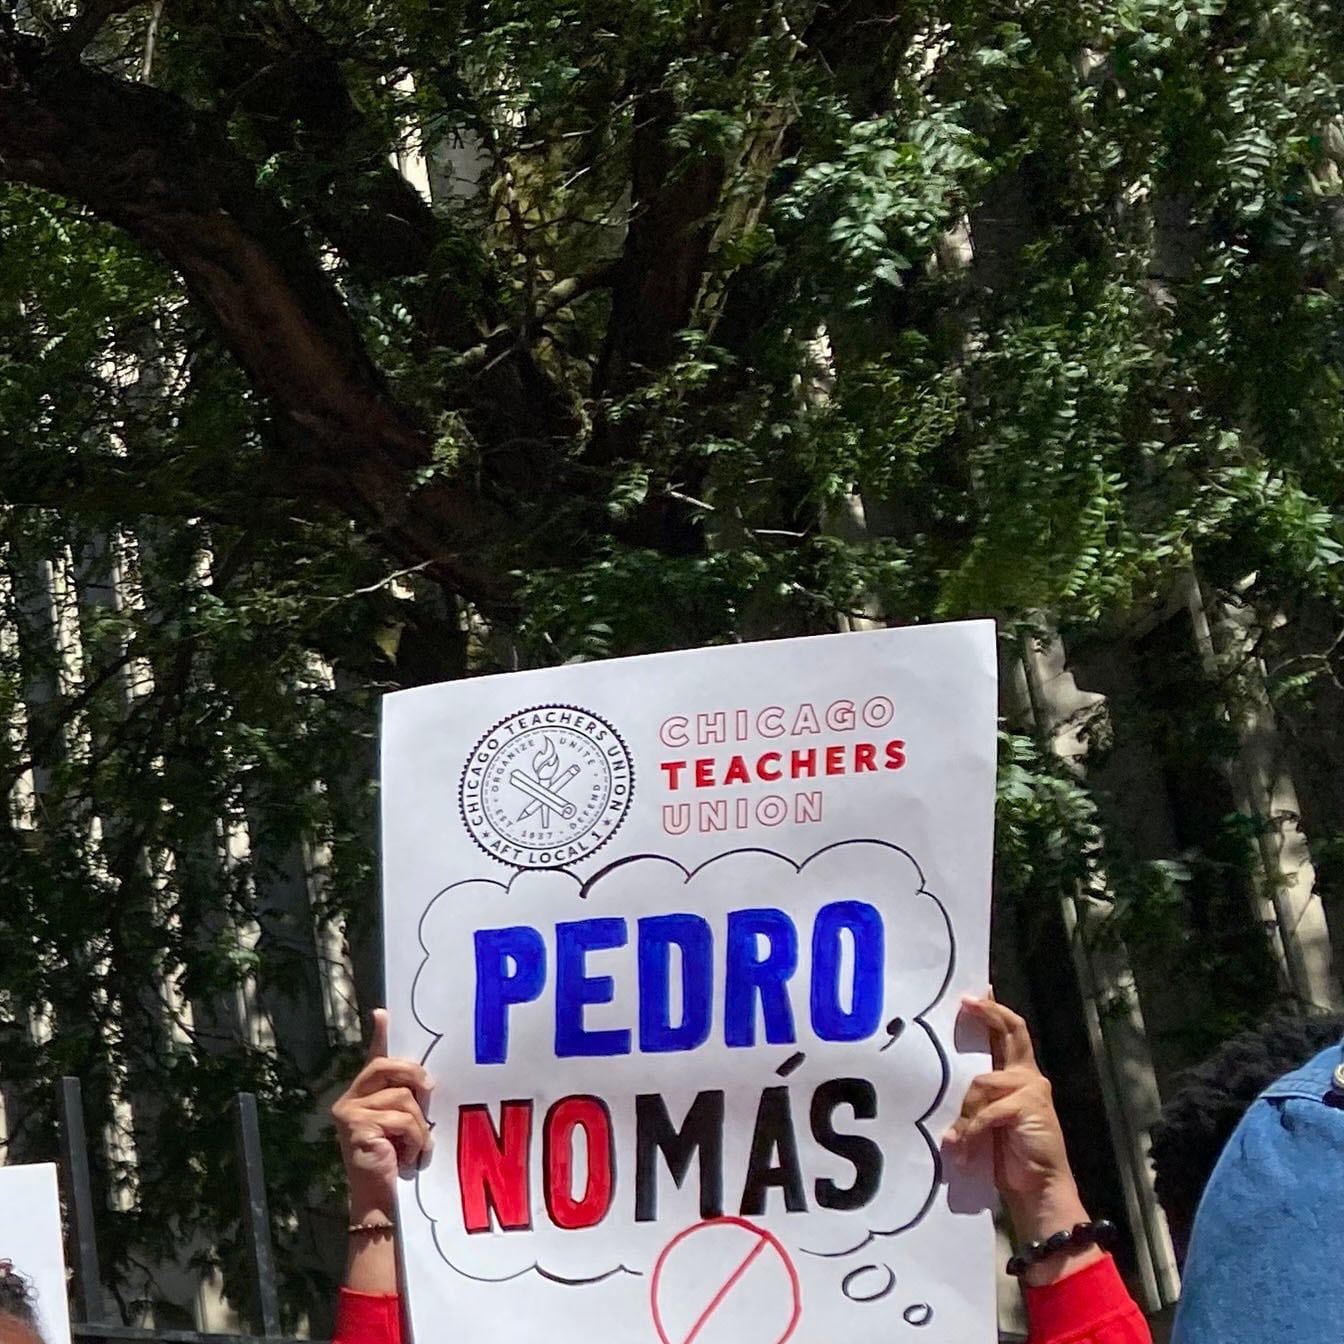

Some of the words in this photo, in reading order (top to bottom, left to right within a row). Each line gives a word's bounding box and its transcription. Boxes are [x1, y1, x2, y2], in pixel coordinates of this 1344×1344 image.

[660, 696, 894, 747] CHICAGO
[466, 738, 498, 826] CHICAGO
[504, 712, 608, 741] TEACHERS
[607, 745, 627, 812] UNION
[661, 739, 907, 790] TEACHERS
[663, 791, 823, 835] UNION
[490, 840, 523, 860] AFT
[528, 841, 589, 863] LOCAL
[473, 899, 906, 1065] PEDRO,
[455, 1093, 615, 1236] NO
[633, 1051, 886, 1225] MÁS
